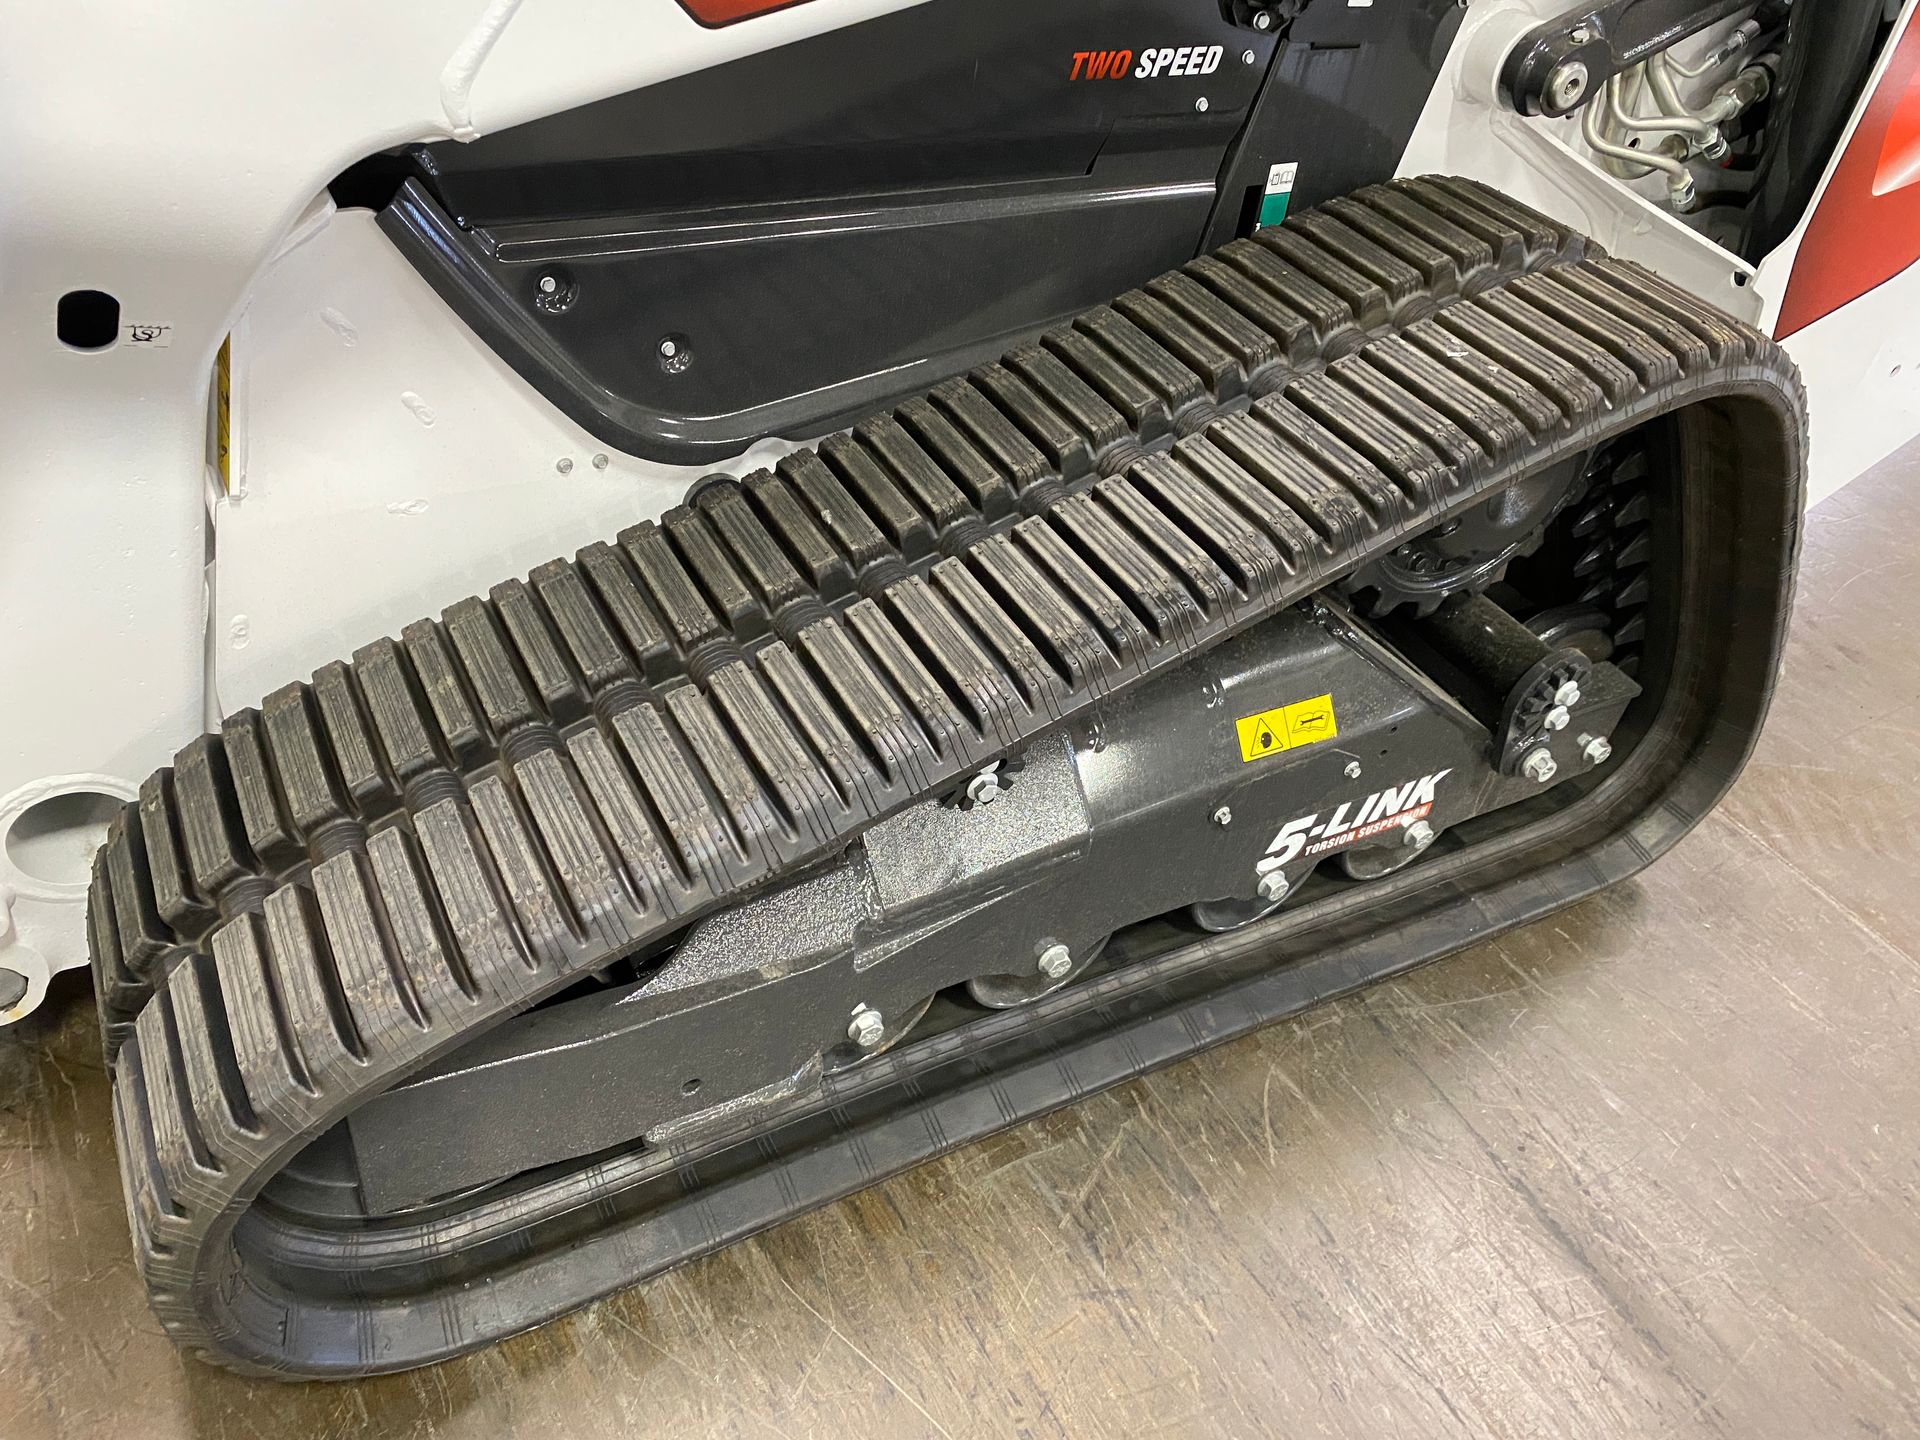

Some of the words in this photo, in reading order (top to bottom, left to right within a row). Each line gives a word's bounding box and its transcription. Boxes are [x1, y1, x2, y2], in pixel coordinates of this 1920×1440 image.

[1069, 50, 1132, 81] TWO
[1134, 46, 1224, 79] SPEED
[1256, 768, 1454, 872] 5-LINK
[1305, 830, 1356, 856] TORSION
